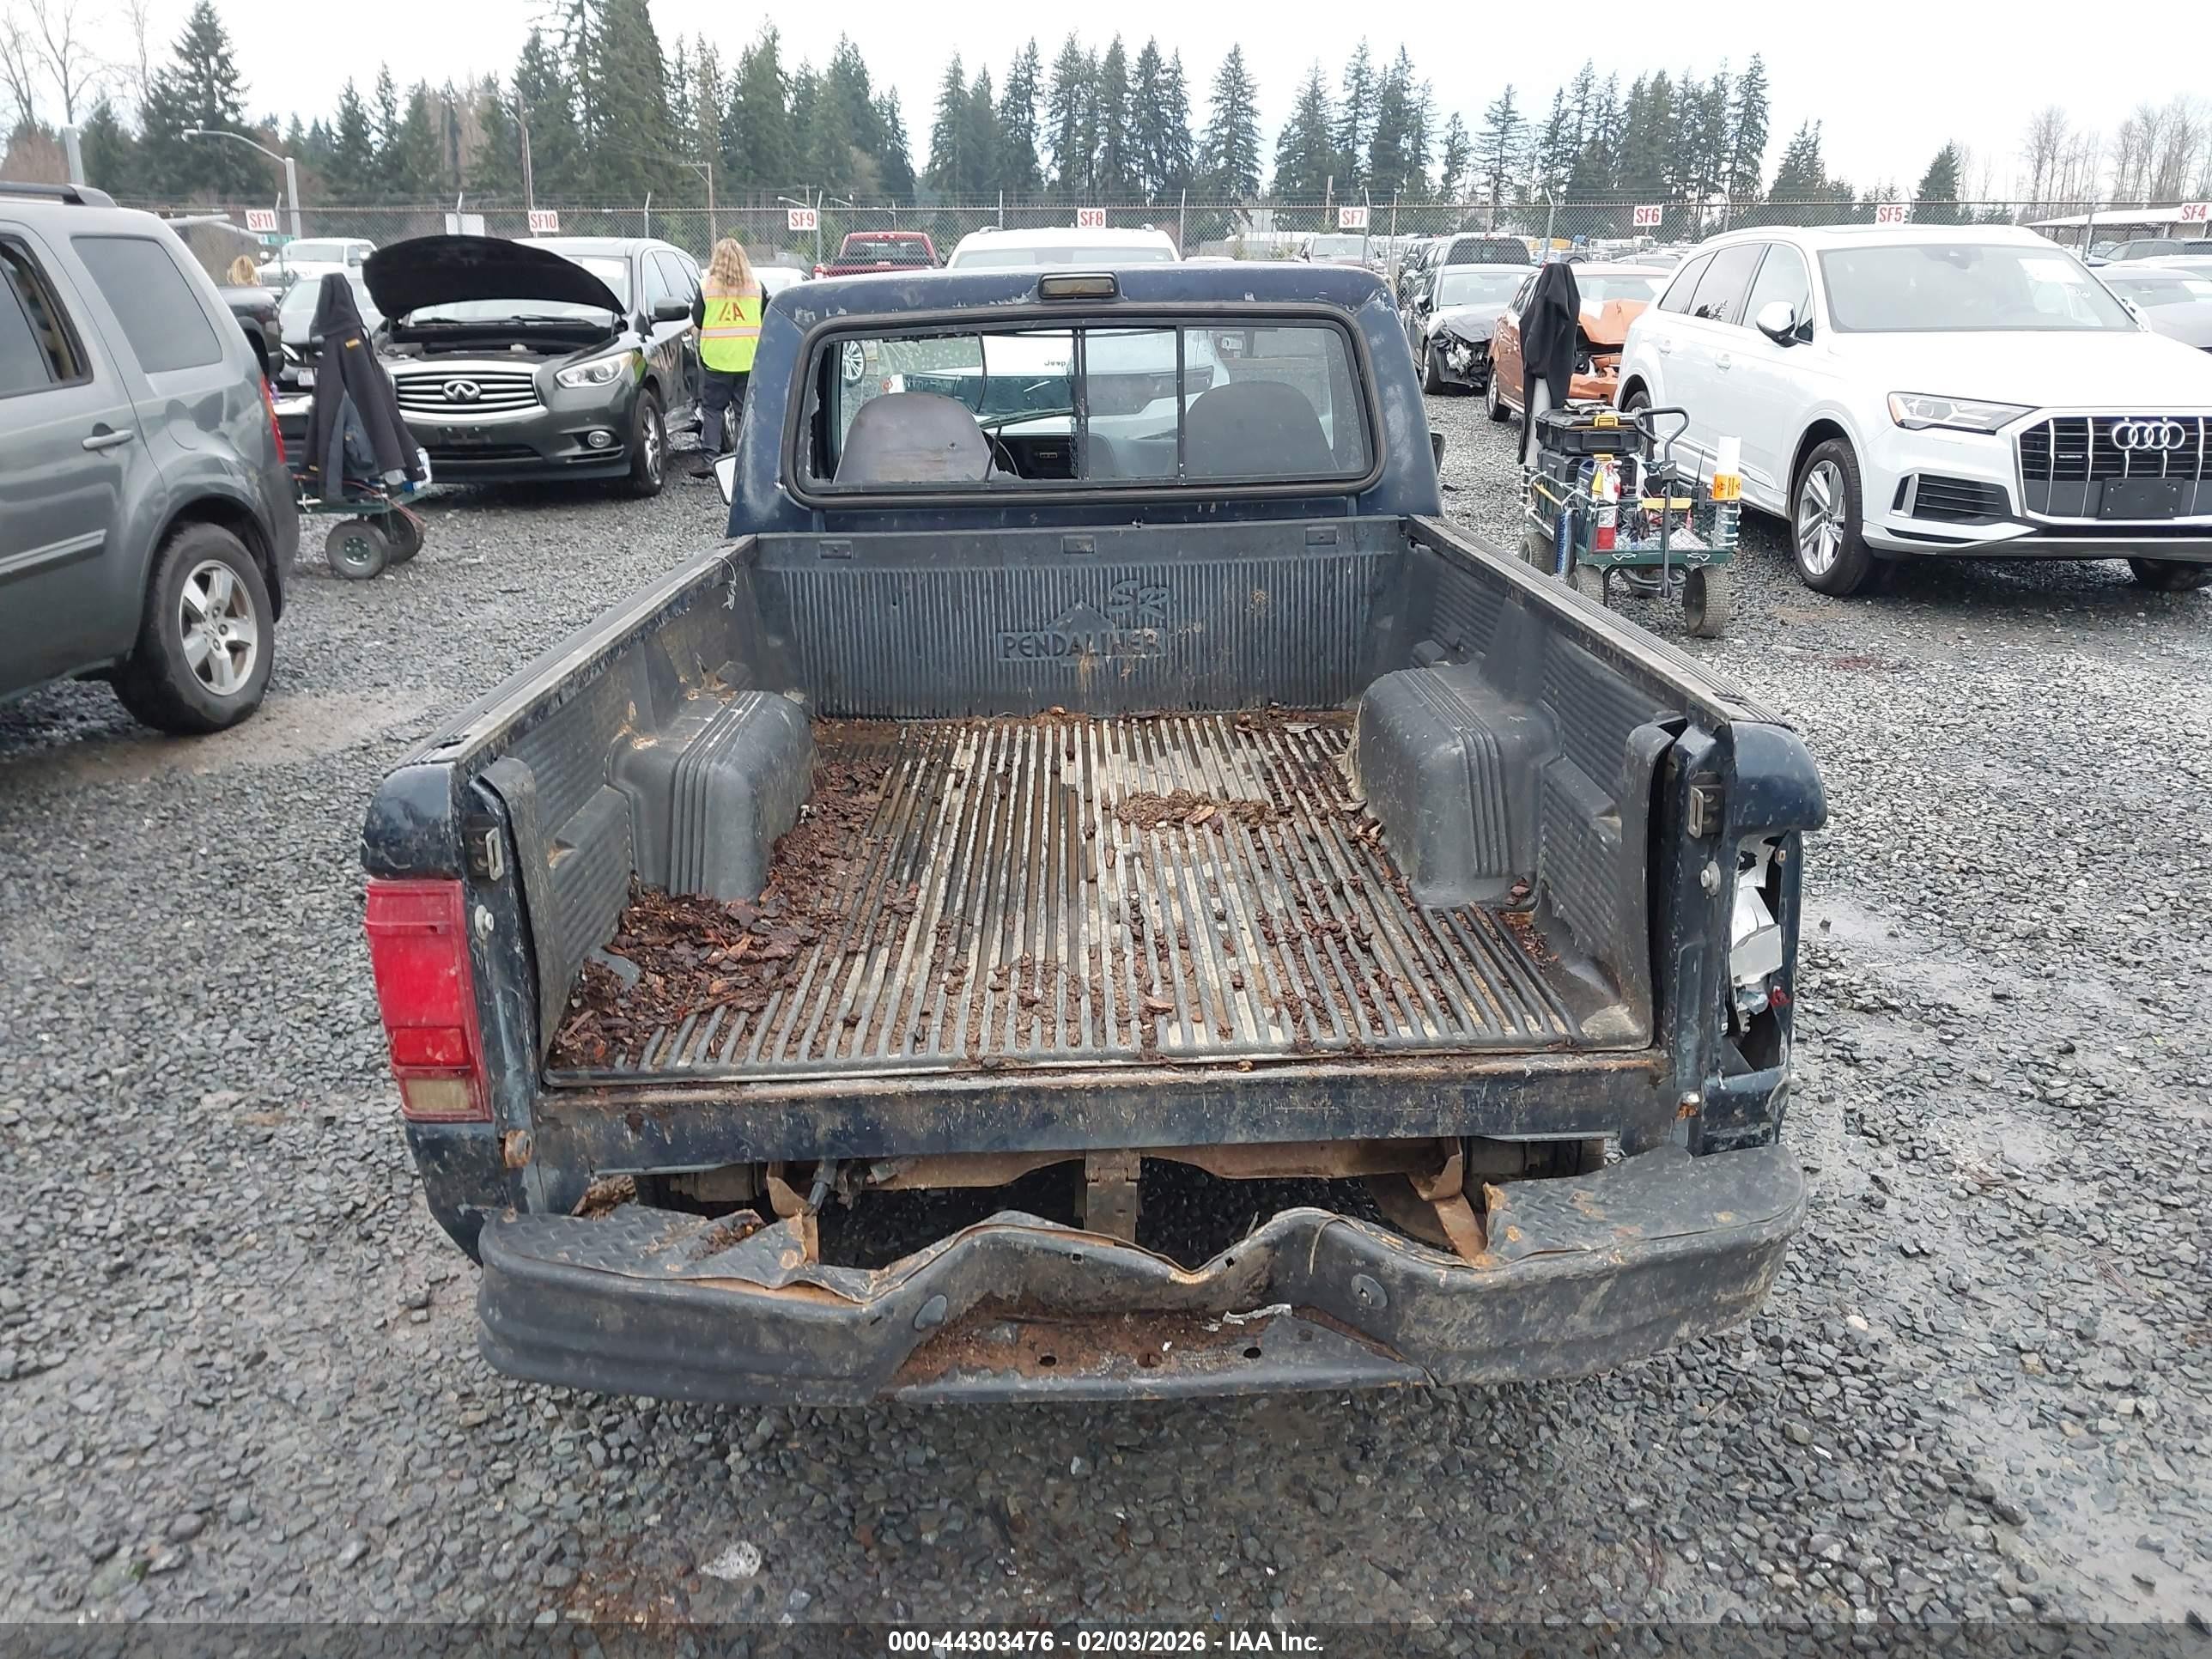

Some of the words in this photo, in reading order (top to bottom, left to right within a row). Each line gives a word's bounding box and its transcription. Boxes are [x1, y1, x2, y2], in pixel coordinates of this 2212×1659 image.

[248, 212, 274, 228] SF11
[791, 211, 815, 228] SF9
[1080, 210, 1103, 227] SF8
[1342, 210, 1364, 226] SF7
[1636, 208, 1660, 224] SF6
[1879, 206, 1903, 223] SF5
[2181, 204, 2208, 221] SF4
[530, 213, 556, 229] SF10
[1043, 358, 1066, 368] Jeep
[1001, 629, 1165, 659] PENDALINER
